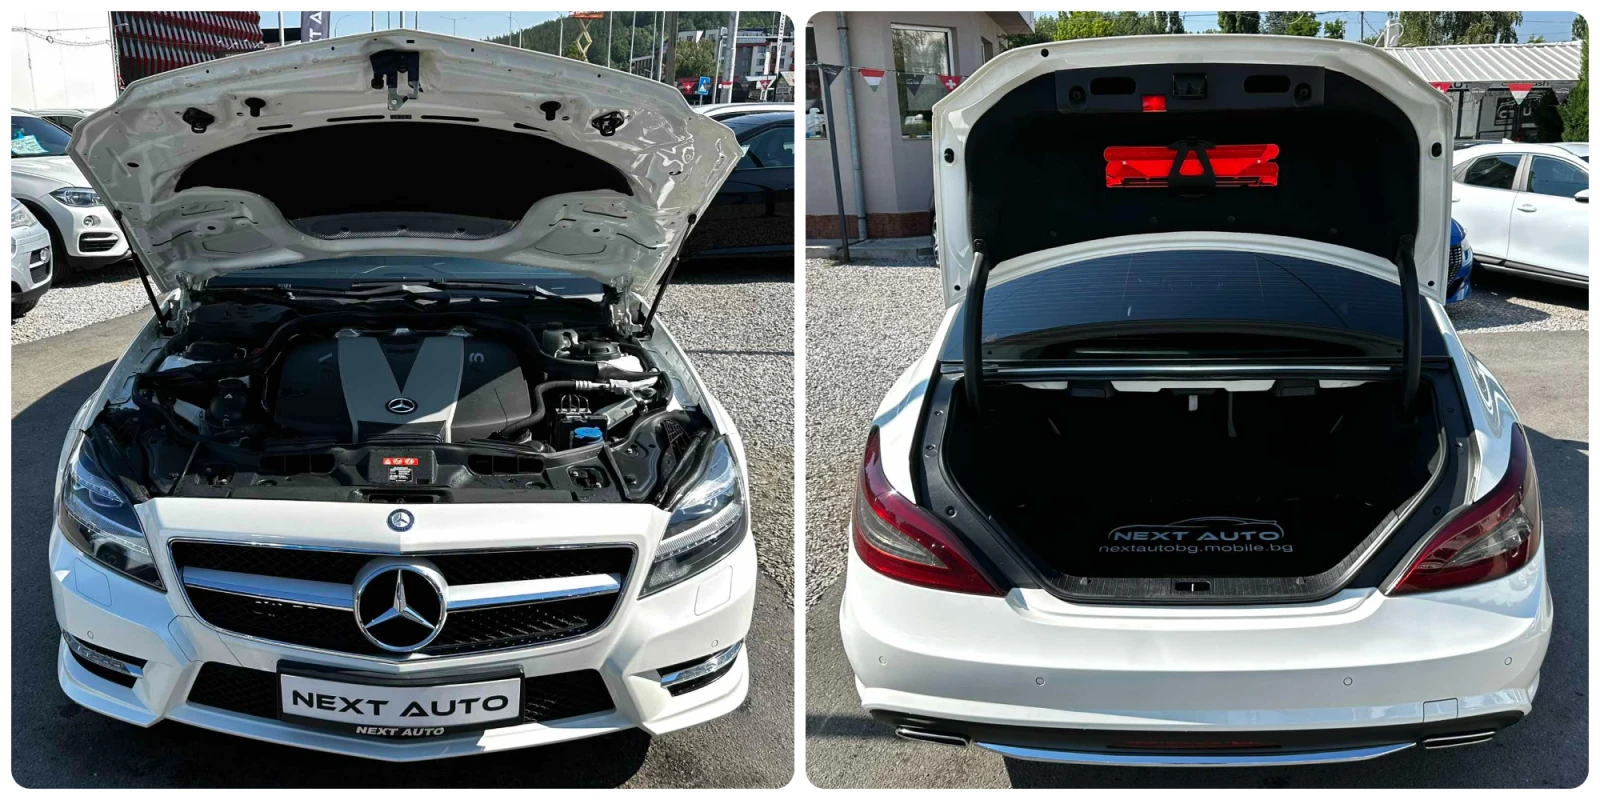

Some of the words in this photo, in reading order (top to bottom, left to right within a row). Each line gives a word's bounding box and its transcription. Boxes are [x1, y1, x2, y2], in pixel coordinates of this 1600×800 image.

[1113, 531, 1190, 541] NEXT
[1196, 531, 1280, 541] AUTO
[1098, 543, 1294, 554] nextautobg.mobile.bg
[292, 689, 389, 716] NEXT
[399, 695, 509, 717] AUTO
[356, 726, 399, 736] NEXT
[401, 726, 445, 737] AUTO
